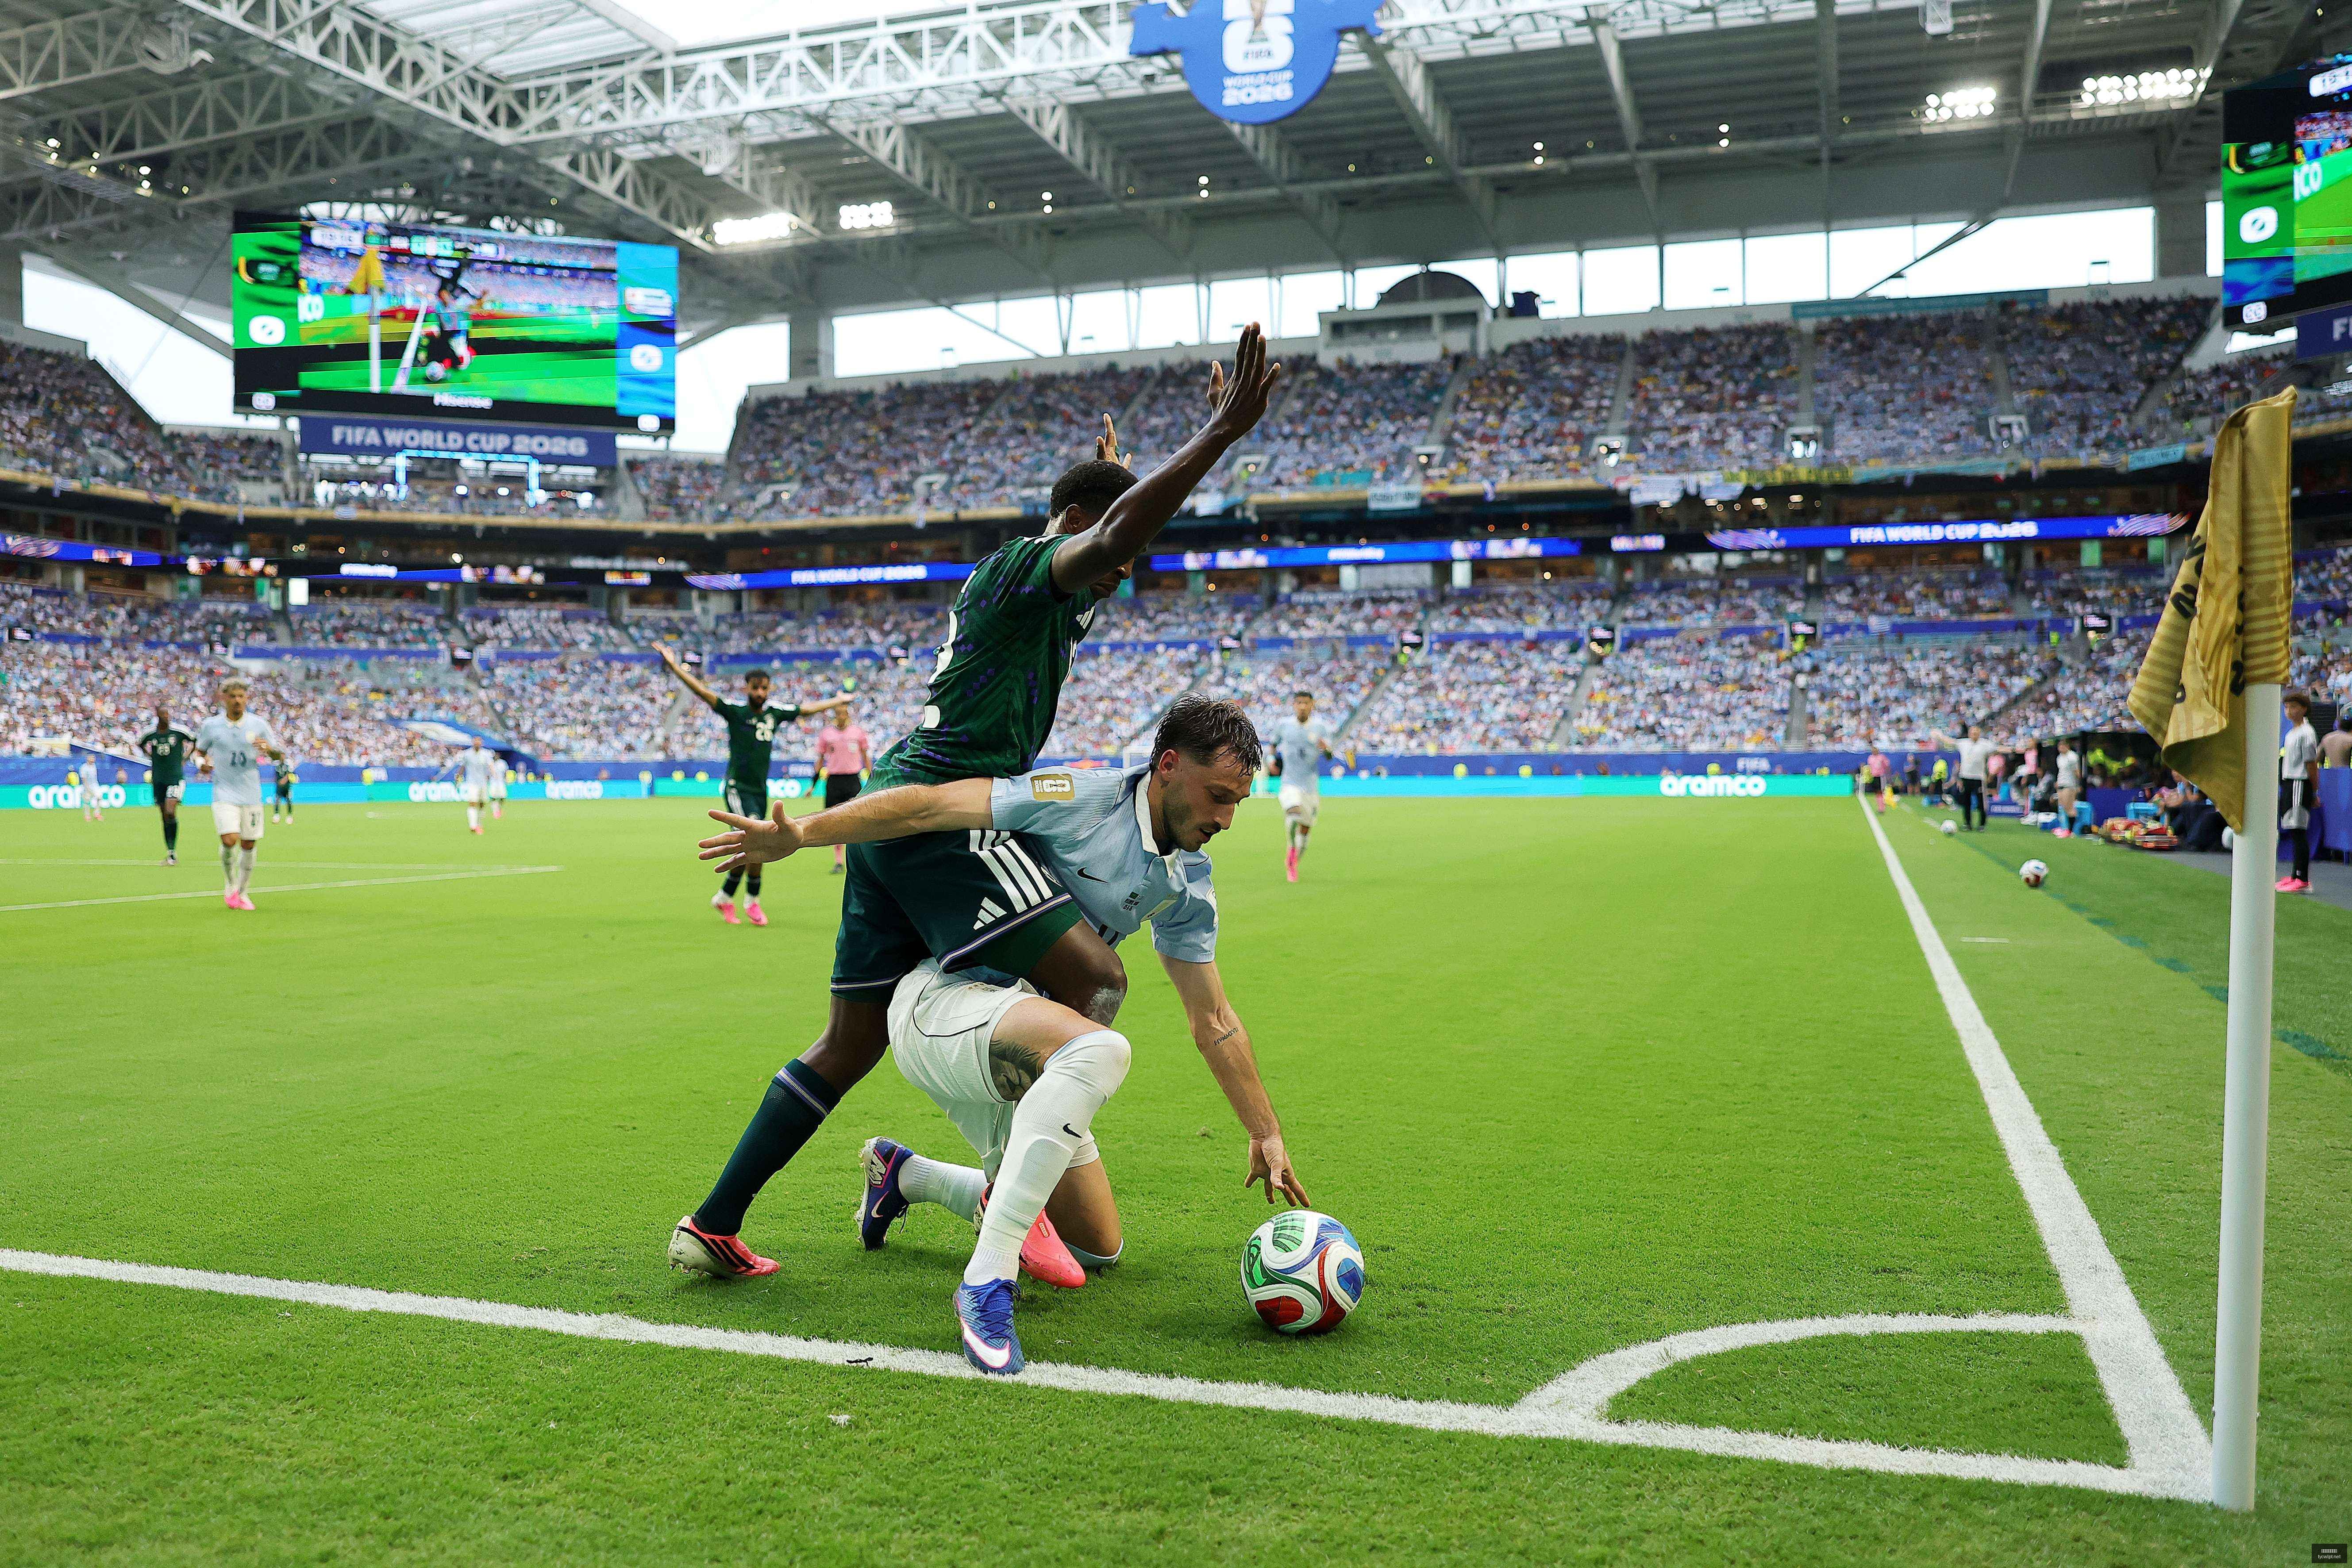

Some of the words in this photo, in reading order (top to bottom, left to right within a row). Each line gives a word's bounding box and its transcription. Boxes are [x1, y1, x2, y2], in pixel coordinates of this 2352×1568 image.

[331, 425, 383, 447] FIFA
[382, 427, 464, 451] WORLD
[465, 433, 512, 453] CUP
[511, 434, 589, 457] 2026
[1850, 526, 1886, 543] FIFA
[1886, 525, 1945, 542] WORLD
[1944, 523, 1979, 540] CUP
[1659, 774, 1767, 797] aramco
